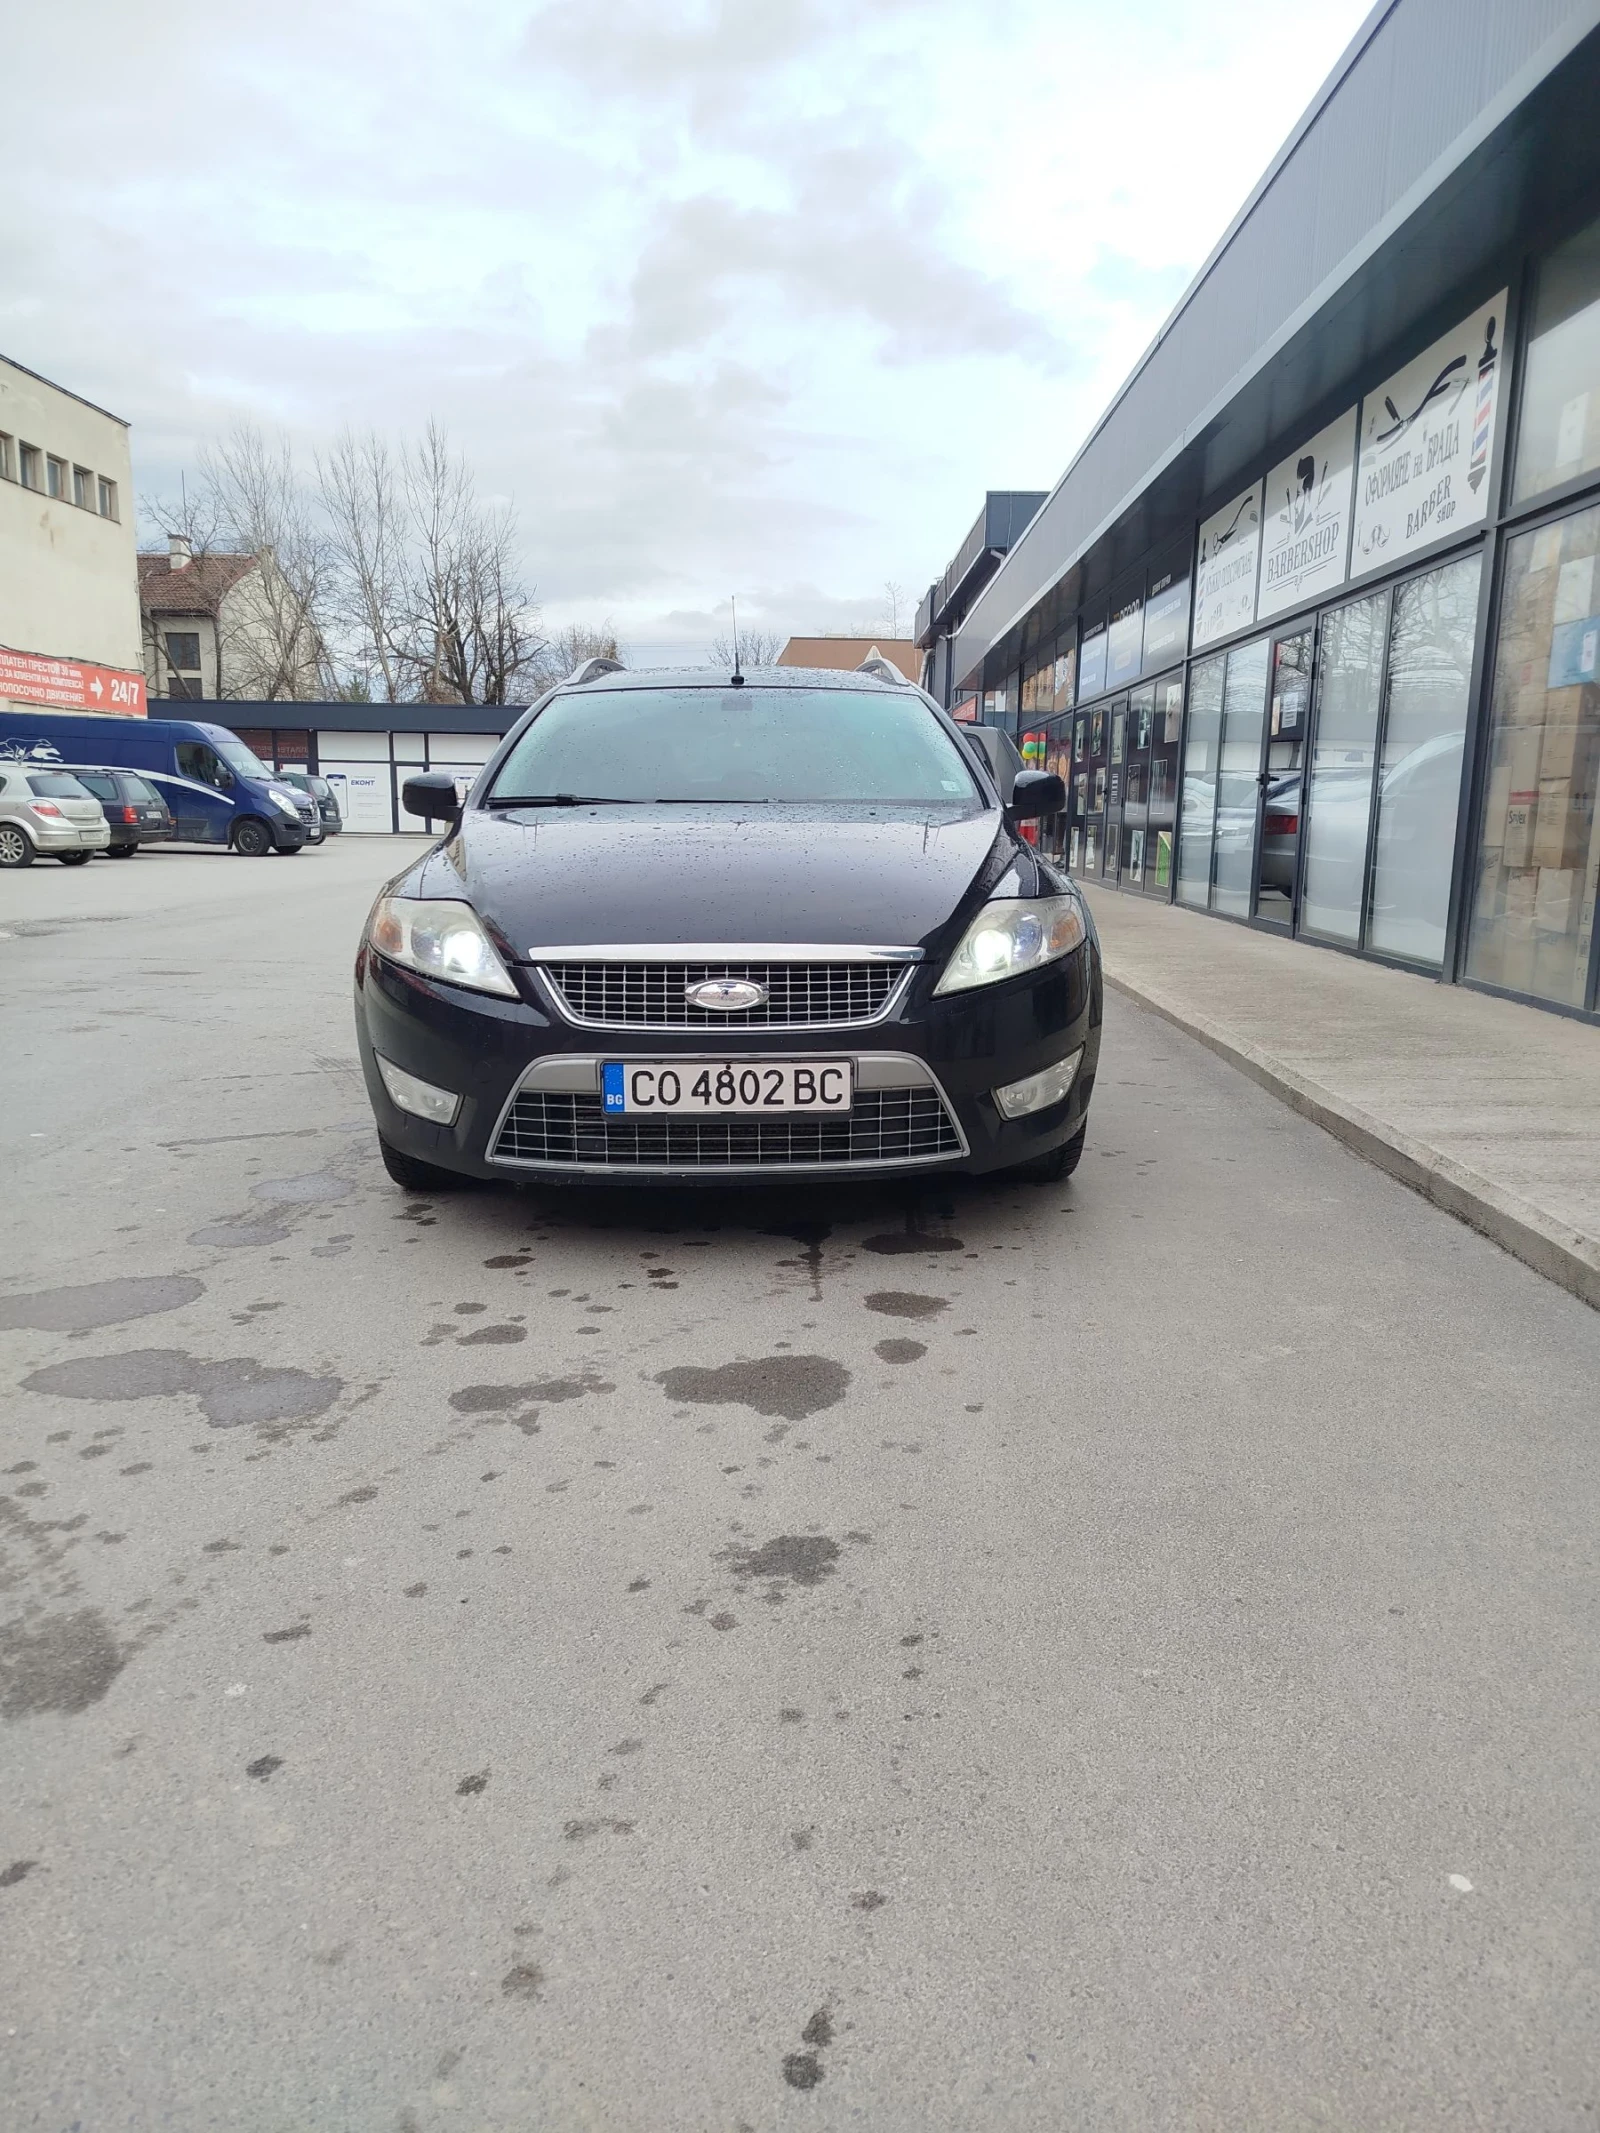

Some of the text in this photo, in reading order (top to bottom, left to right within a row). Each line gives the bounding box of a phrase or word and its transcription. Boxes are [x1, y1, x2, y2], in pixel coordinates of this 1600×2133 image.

[1426, 418, 1460, 473] БРАДА
[1406, 474, 1451, 539] BARBER
[1436, 500, 1456, 524] SHOP
[1267, 521, 1340, 584] BARBERSHOP
[28, 660, 60, 675] ПРЕСТОЙ
[110, 678, 139, 706] 24/7
[606, 1094, 623, 1105] BG
[631, 1068, 843, 1106] CO 4802 BC
